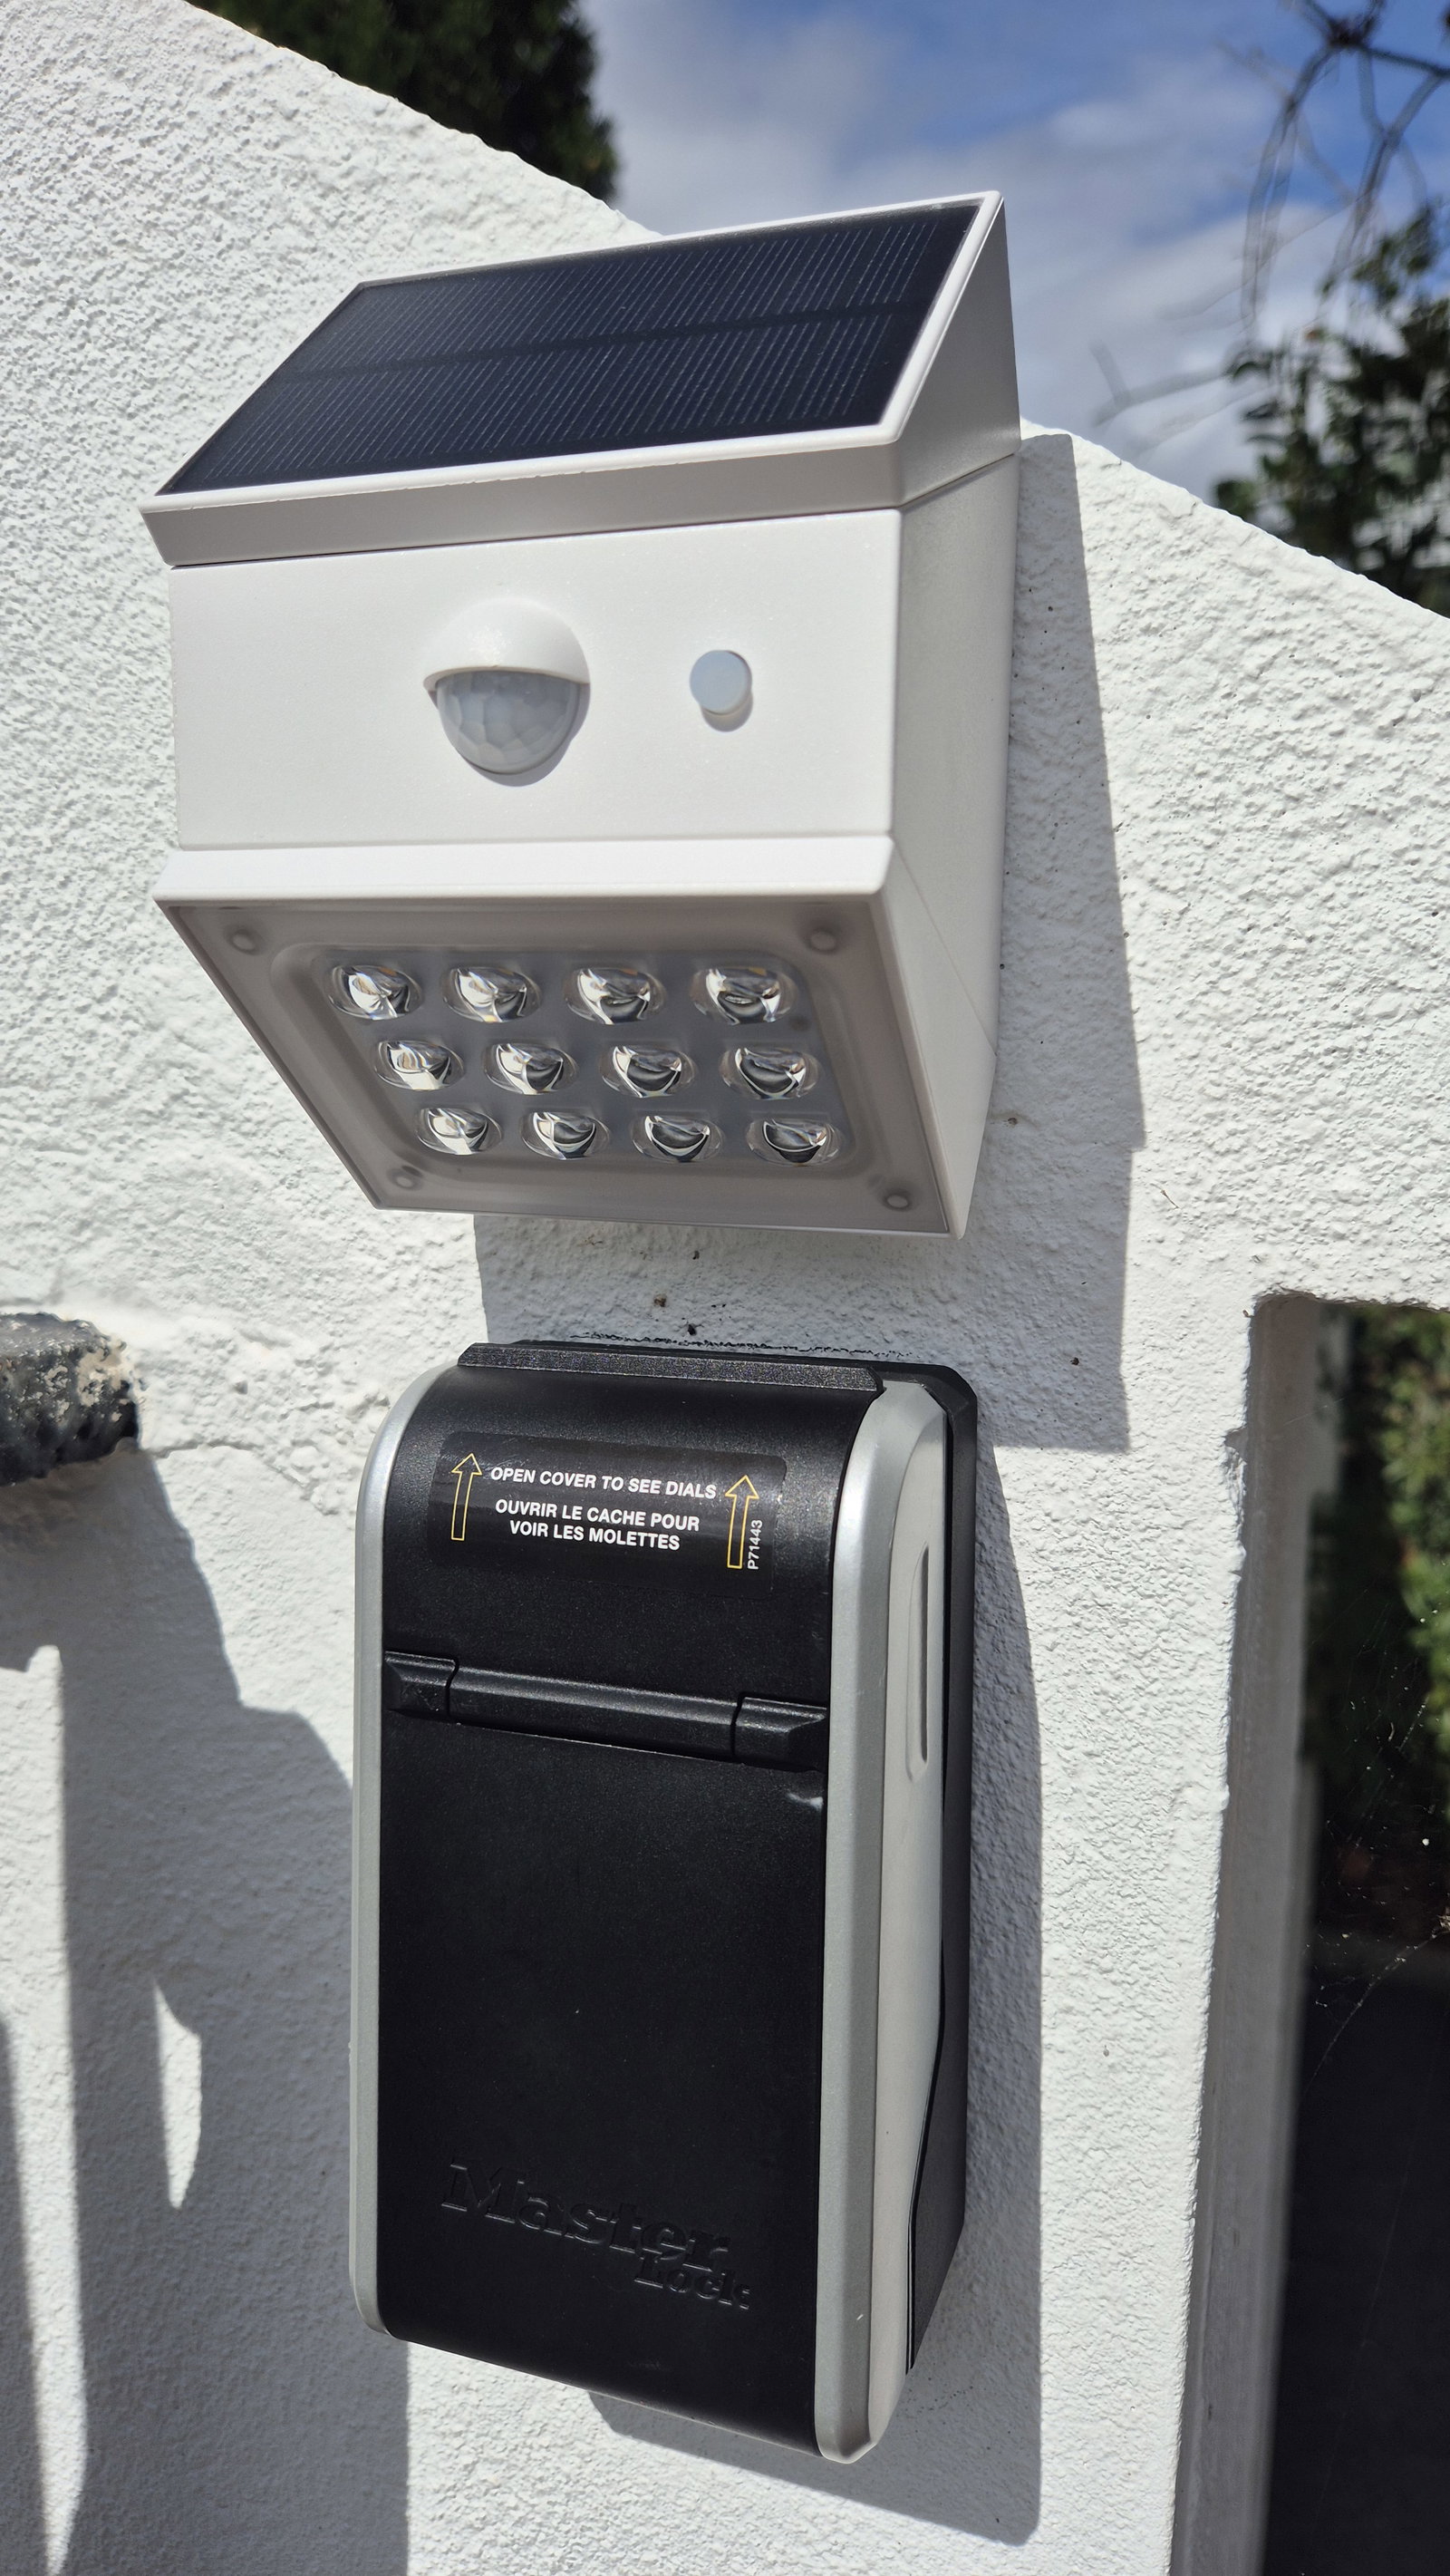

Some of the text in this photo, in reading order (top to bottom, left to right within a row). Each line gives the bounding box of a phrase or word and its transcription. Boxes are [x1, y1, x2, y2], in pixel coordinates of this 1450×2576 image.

[490, 1466, 718, 1500] OPEN COVER TO SEE DIALS
[495, 1498, 701, 1532] OUVRIR LE CACHE POUR
[509, 1519, 681, 1551] VOIR LES MOLETTES
[747, 1519, 763, 1570] P71443
[440, 2162, 731, 2273] Master
